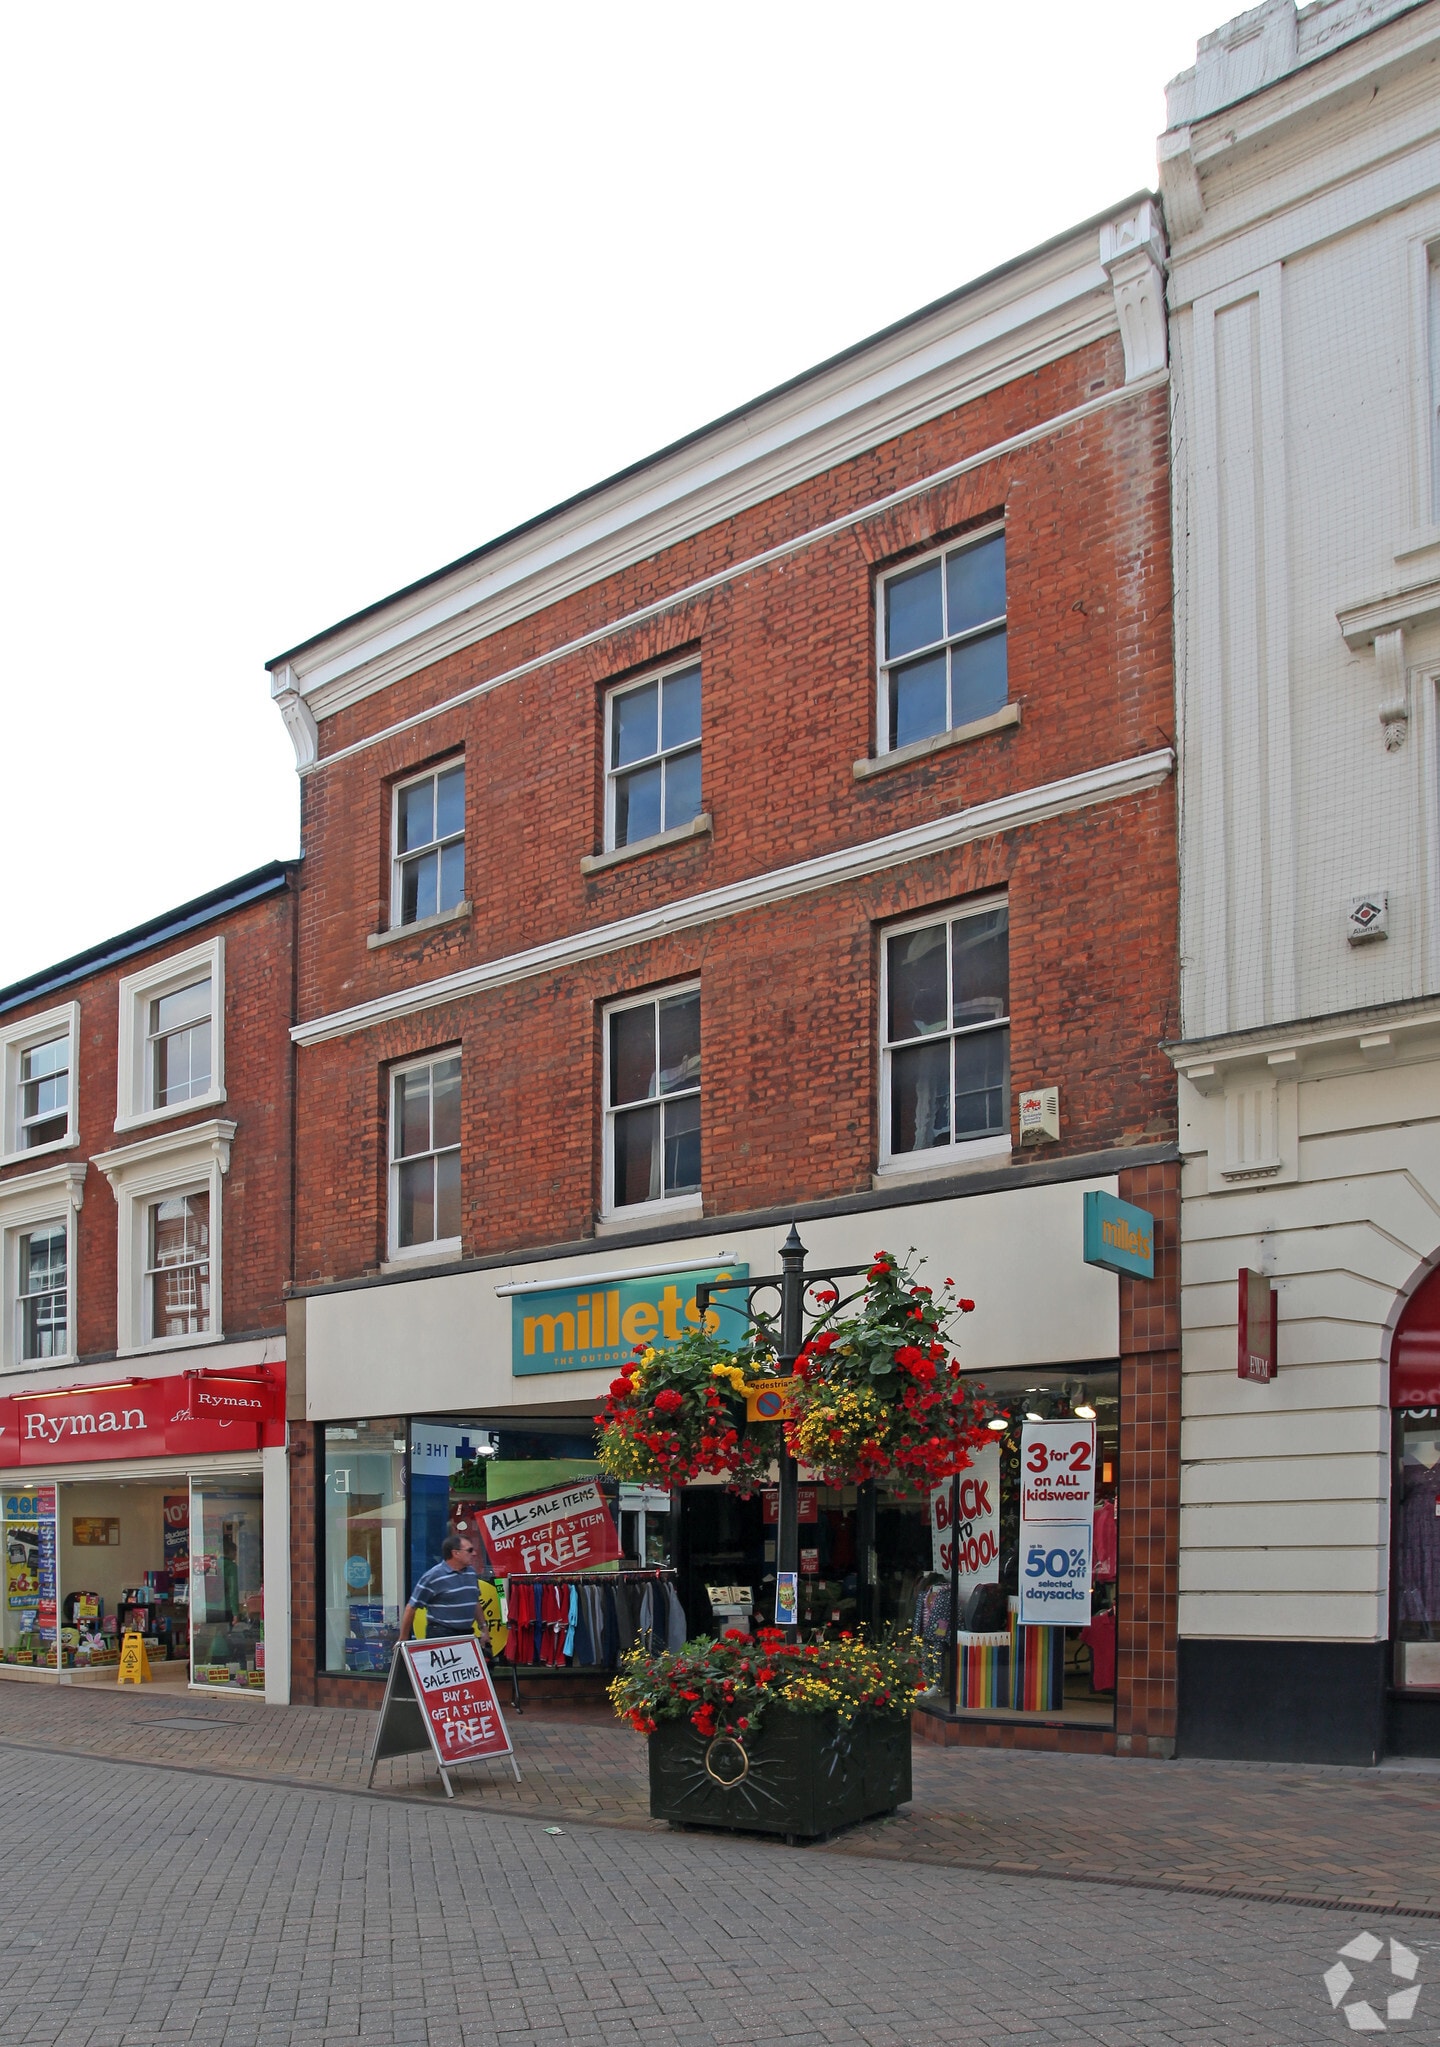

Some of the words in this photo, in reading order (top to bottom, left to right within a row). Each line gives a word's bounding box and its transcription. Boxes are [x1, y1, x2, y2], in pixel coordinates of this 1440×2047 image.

[1103, 1218, 1150, 1260] millets
[523, 1285, 721, 1355] millets
[1250, 1355, 1268, 1377] EWM
[198, 1393, 262, 1408] Ryman
[24, 1409, 147, 1443] Ryman
[1027, 1443, 1048, 1472] 3
[1049, 1450, 1069, 1461] for
[1069, 1442, 1091, 1471] 2
[1034, 1477, 1051, 1486] on
[1055, 1475, 1080, 1486] ALL
[1027, 1489, 1090, 1501] kidswear
[491, 1509, 528, 1531] ALL
[530, 1500, 560, 1518] SALE
[563, 1488, 595, 1508] ITEMS
[770, 1500, 811, 1516] FE
[494, 1537, 516, 1552] BUY
[531, 1527, 552, 1542] GET
[556, 1525, 565, 1535] A
[580, 1513, 605, 1528] ITEM
[520, 1531, 591, 1573] FREE
[1025, 1549, 1086, 1577] 50%
[1068, 1567, 1086, 1578] off
[1026, 1588, 1085, 1602] daysacks
[430, 1648, 462, 1668] ALL
[423, 1672, 451, 1688] SALE
[452, 1666, 480, 1682] ITEMS
[442, 1690, 460, 1703] BUY
[431, 1707, 450, 1720] GET
[453, 1706, 460, 1717] A
[473, 1700, 494, 1713] ITEM
[442, 1715, 496, 1748] FREE
